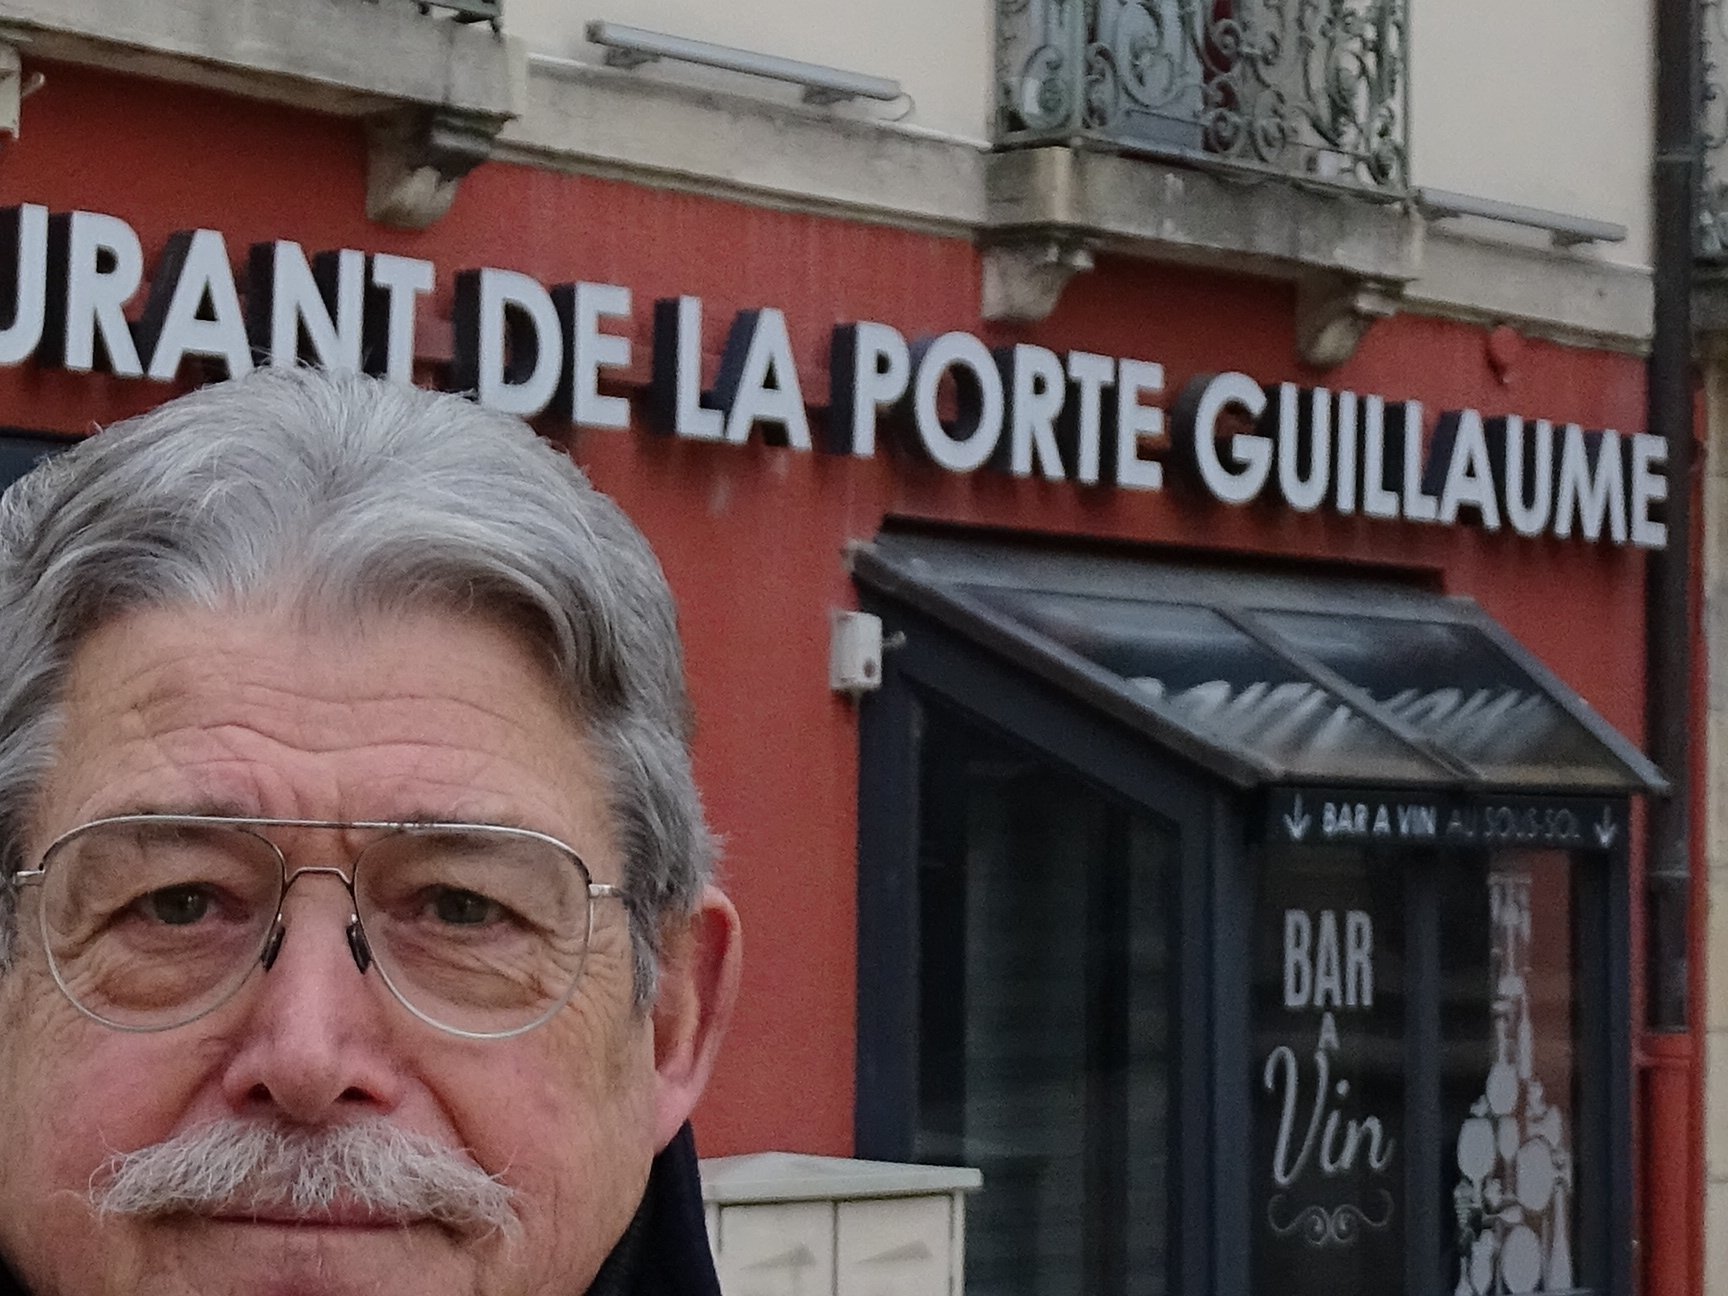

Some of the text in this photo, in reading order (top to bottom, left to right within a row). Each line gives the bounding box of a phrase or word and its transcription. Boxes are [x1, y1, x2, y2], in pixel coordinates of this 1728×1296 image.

[464, 266, 632, 430] DE
[664, 292, 813, 452] LA
[840, 318, 1165, 492] PORTE
[1180, 369, 1669, 550] GUILLAUME
[1322, 801, 1369, 836] BAR
[1397, 804, 1437, 837] VIN
[1283, 908, 1373, 1007] BAR
[1263, 1044, 1397, 1187] Vin
